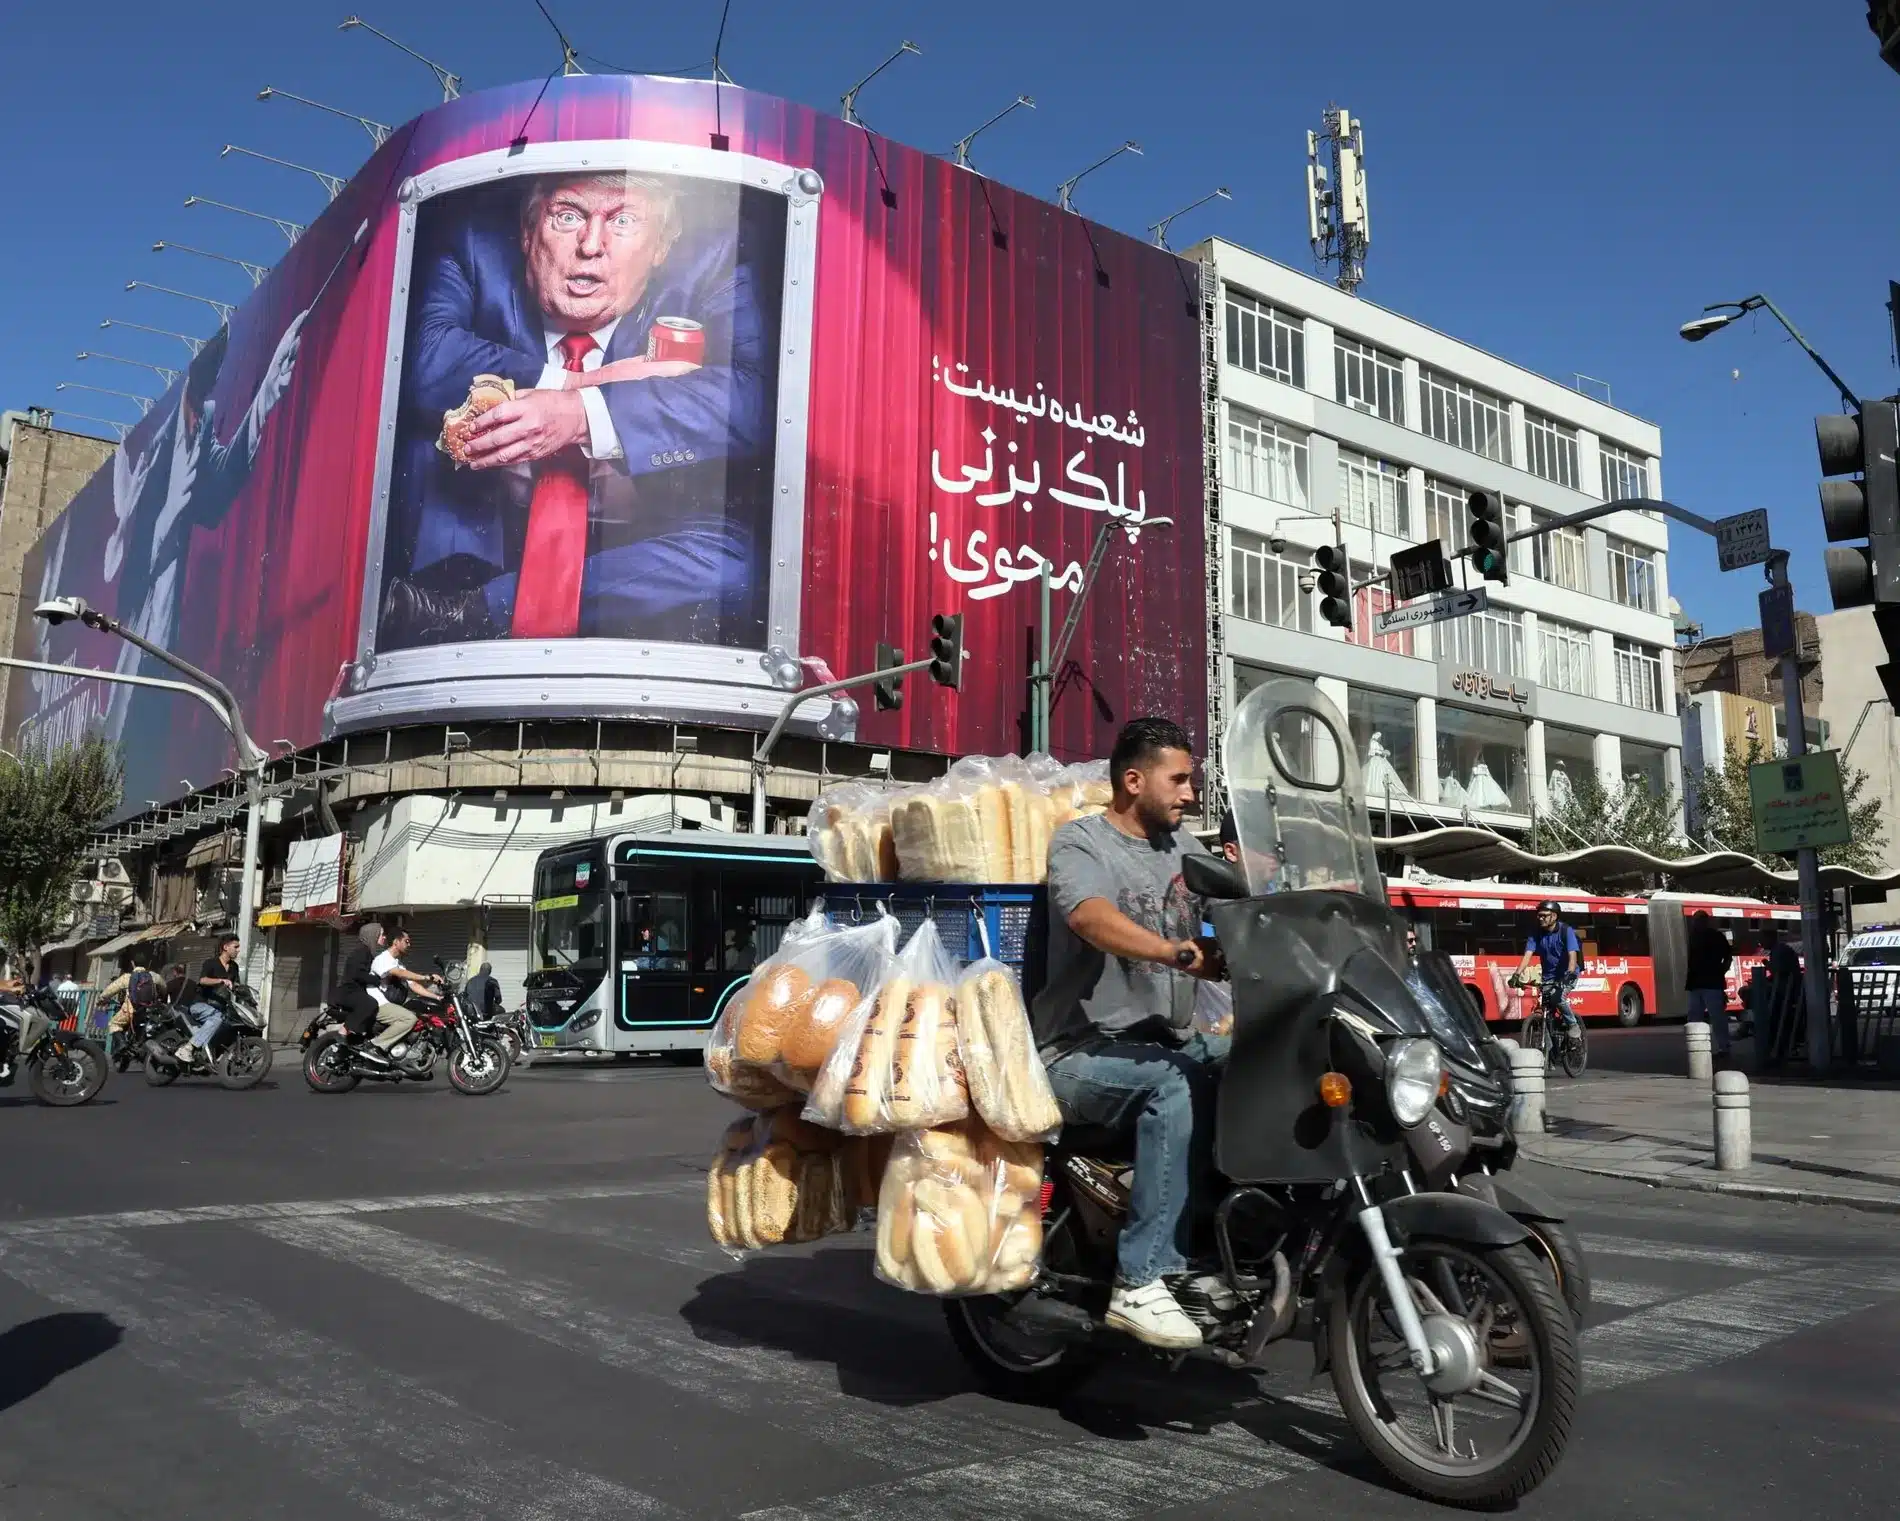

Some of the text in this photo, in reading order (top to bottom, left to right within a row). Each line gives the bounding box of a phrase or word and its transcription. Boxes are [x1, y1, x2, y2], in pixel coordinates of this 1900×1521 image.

[932, 354, 1146, 448] شعبده نیست!
[931, 425, 1147, 545] پلک بزنی
[1379, 605, 1445, 630] جمهوری اسلامی
[1452, 671, 1530, 713] پاساژ آزاد
[1596, 957, 1628, 975] اقساط
